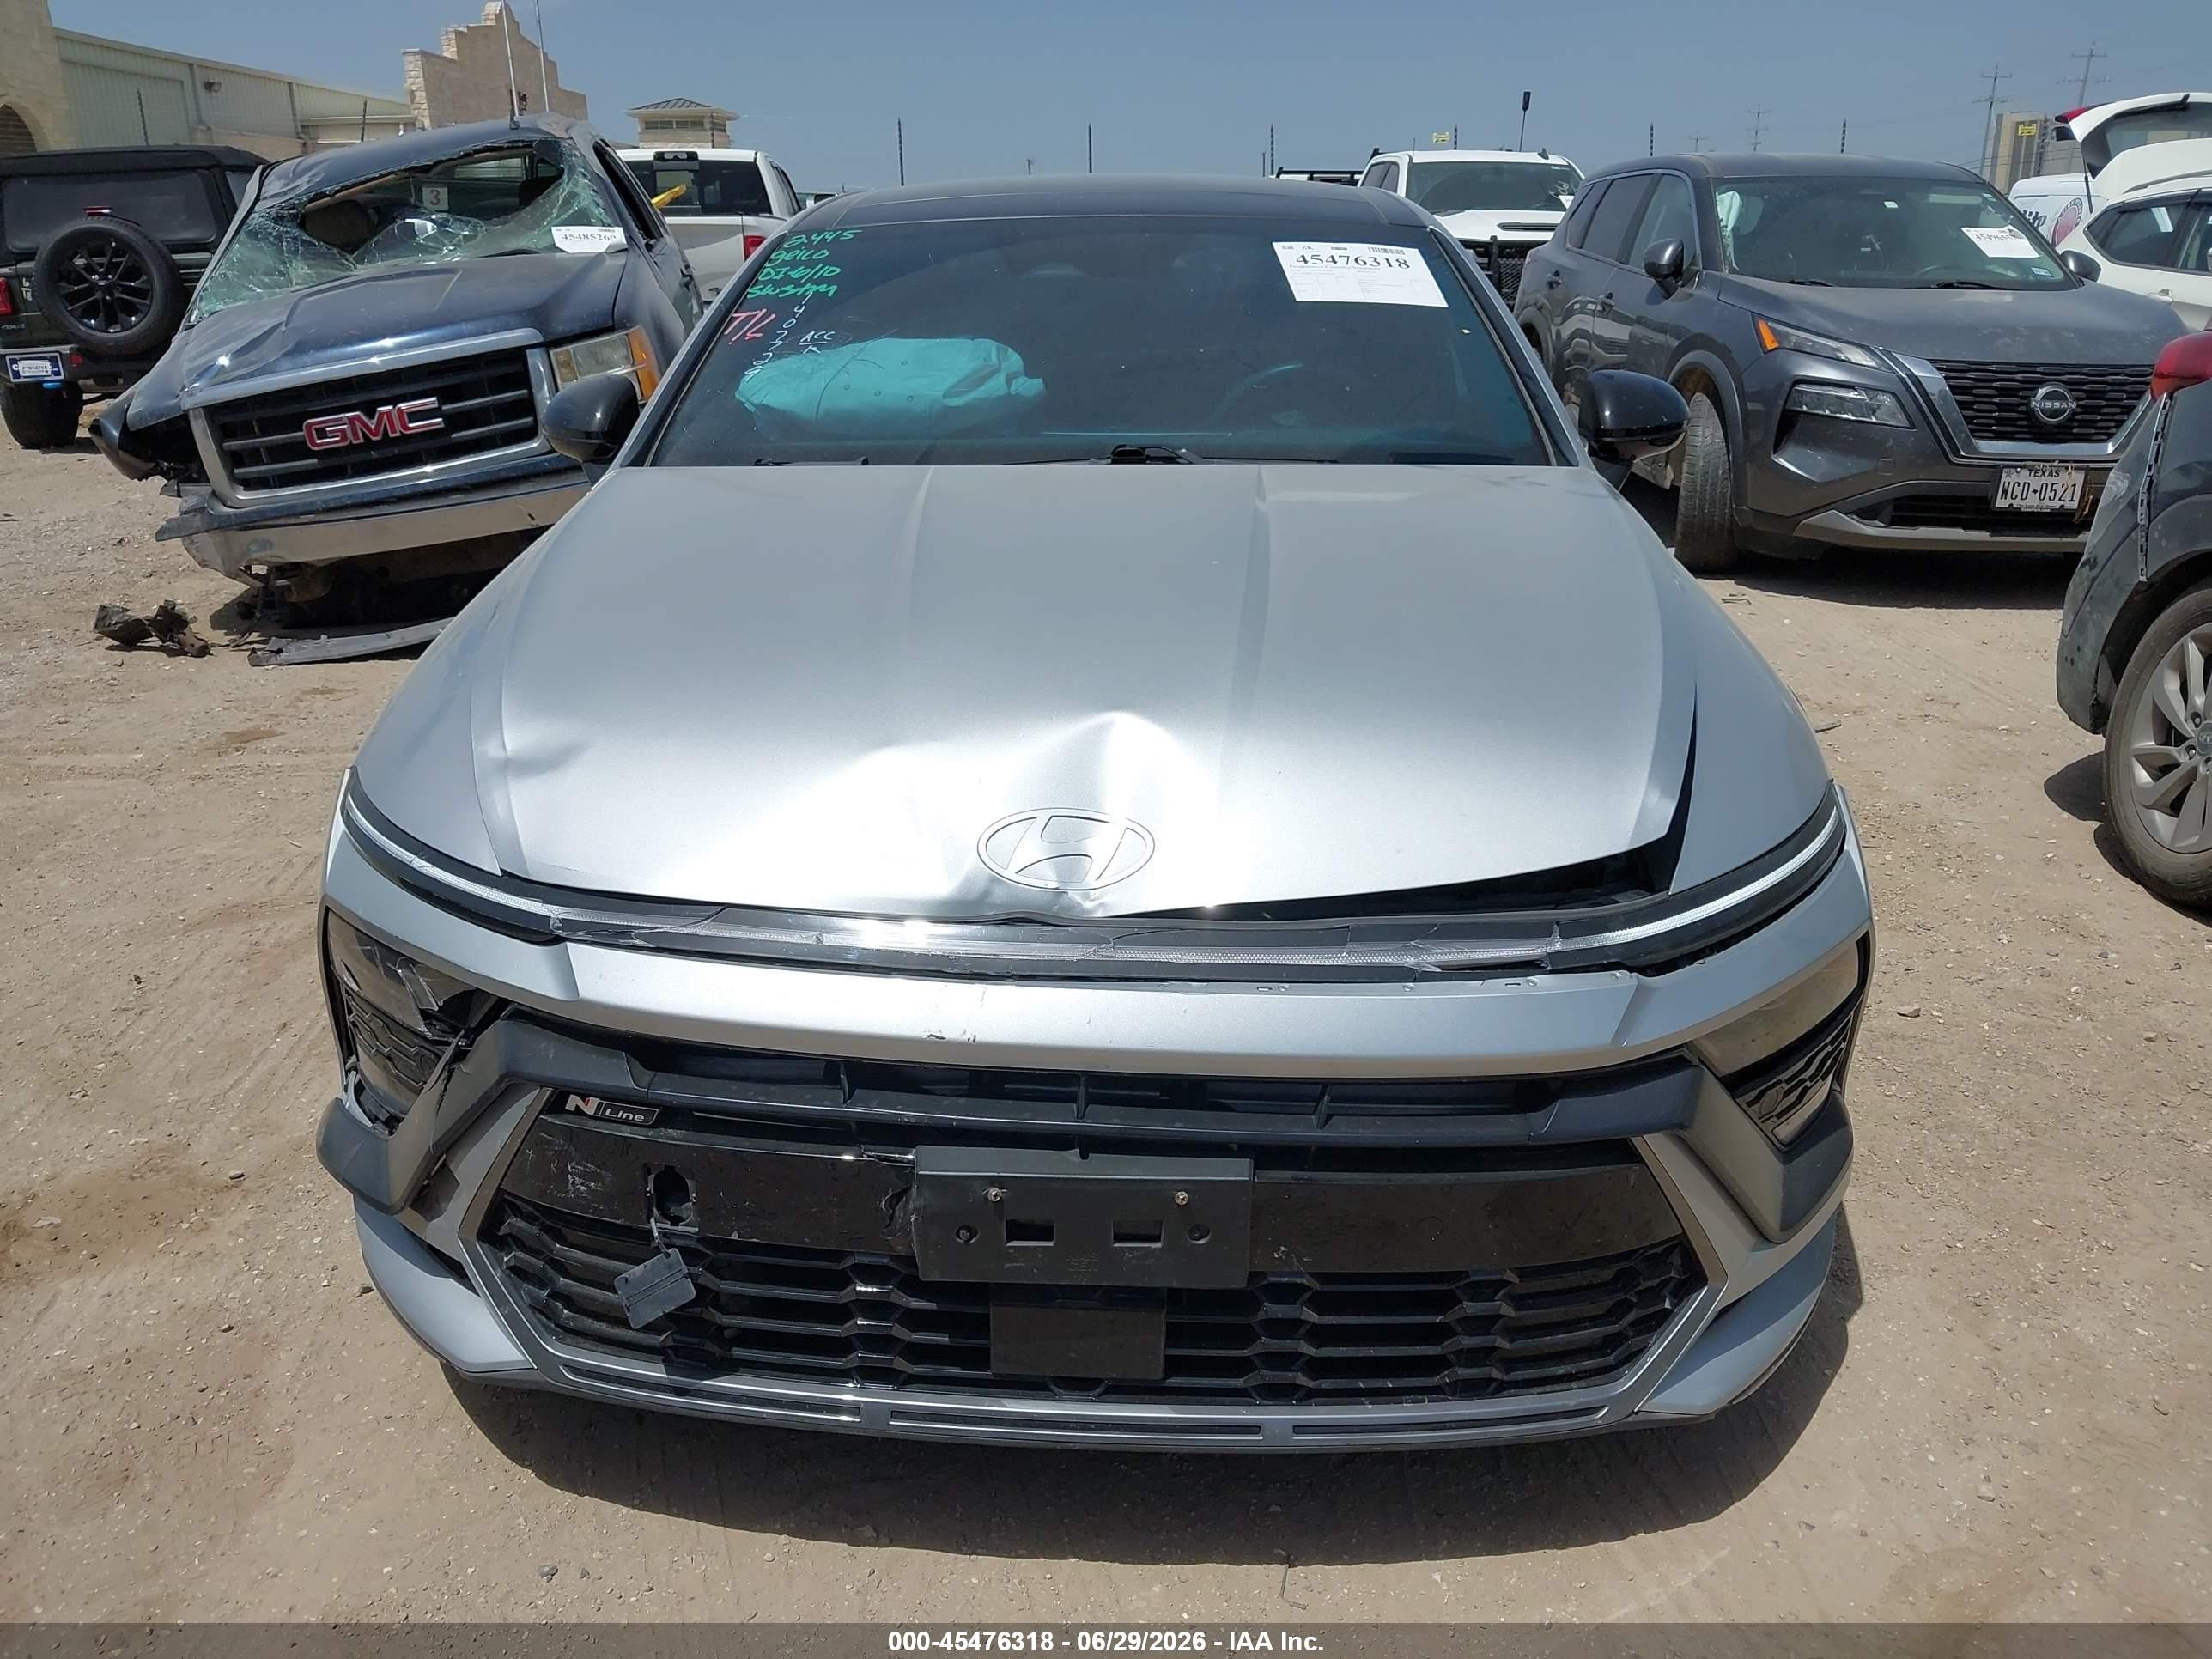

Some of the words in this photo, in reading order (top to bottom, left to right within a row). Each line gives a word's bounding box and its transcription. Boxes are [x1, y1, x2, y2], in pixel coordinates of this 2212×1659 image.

[430, 189, 441, 206] 3
[1296, 253, 1411, 270] 45476318
[302, 396, 445, 451] GMC
[2027, 468, 2061, 478] TEXAS
[604, 1108, 646, 1122] Line
